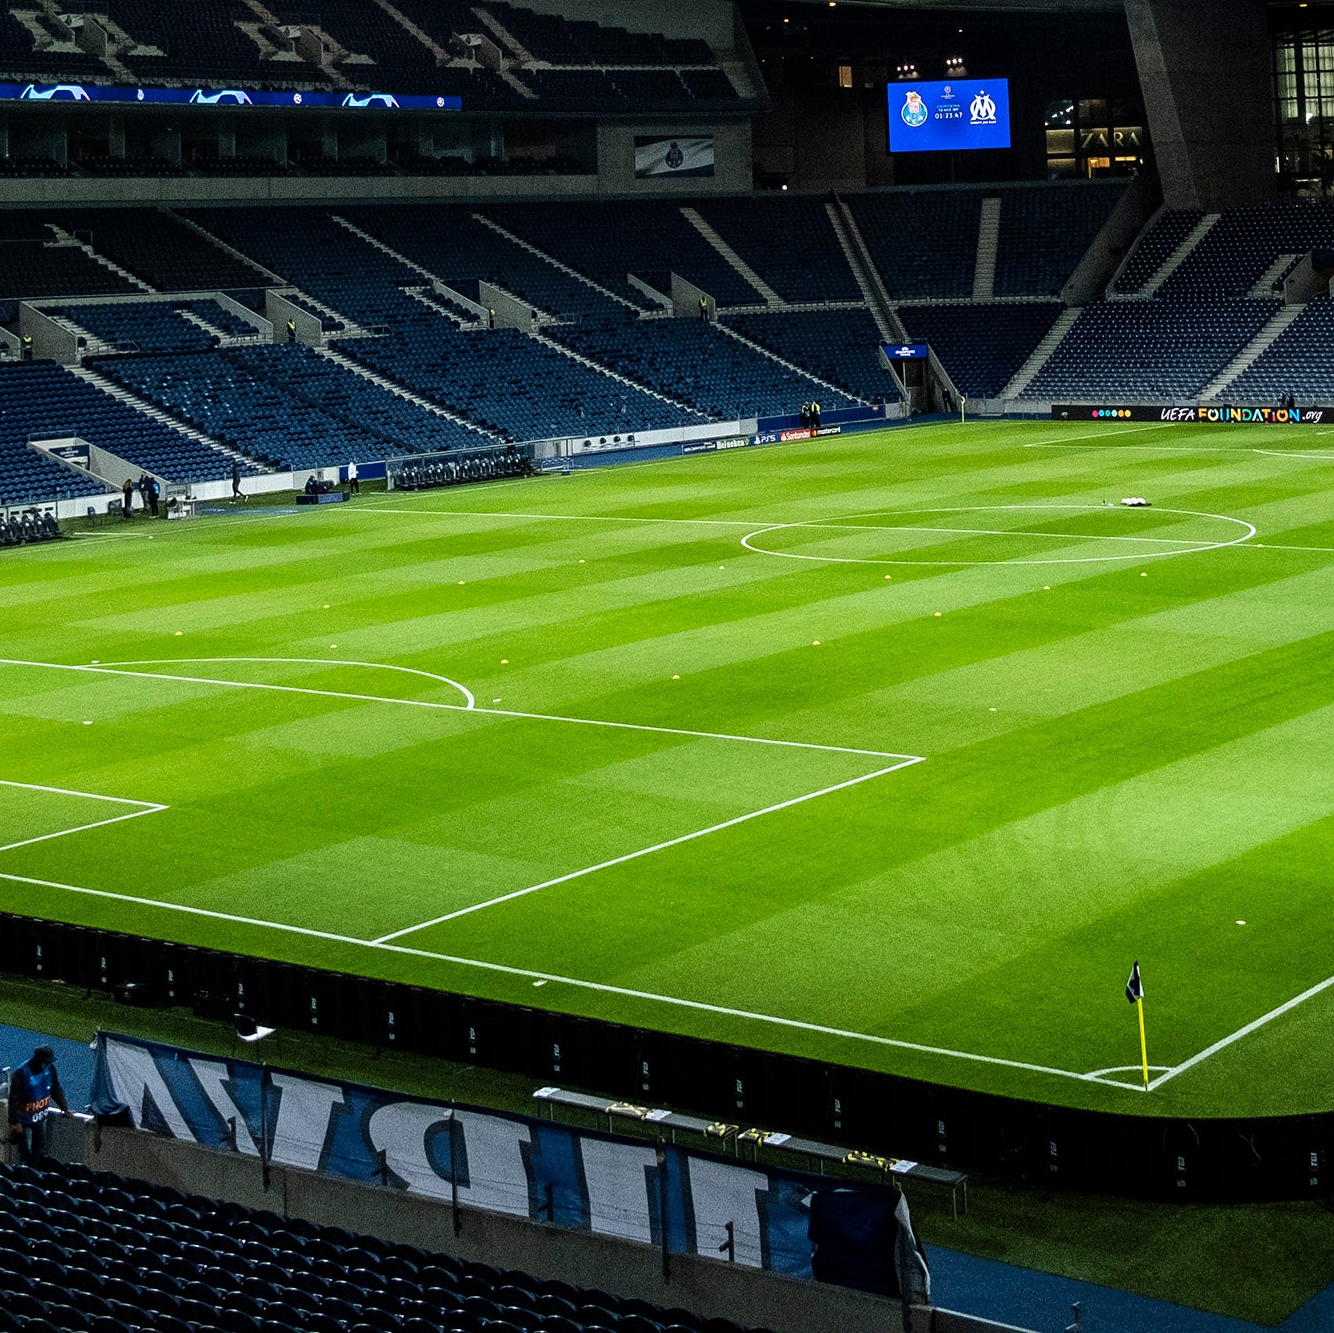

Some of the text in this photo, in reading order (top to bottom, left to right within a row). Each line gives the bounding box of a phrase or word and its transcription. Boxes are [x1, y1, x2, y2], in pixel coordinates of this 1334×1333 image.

[1081, 131, 1142, 148] ZARA
[1160, 408, 1195, 421] UEFA
[1197, 408, 1300, 423] FOUNDATION
[786, 429, 811, 441] Santander
[818, 426, 841, 436] mastercard
[761, 434, 776, 443] PS5
[717, 439, 745, 450] Heineken
